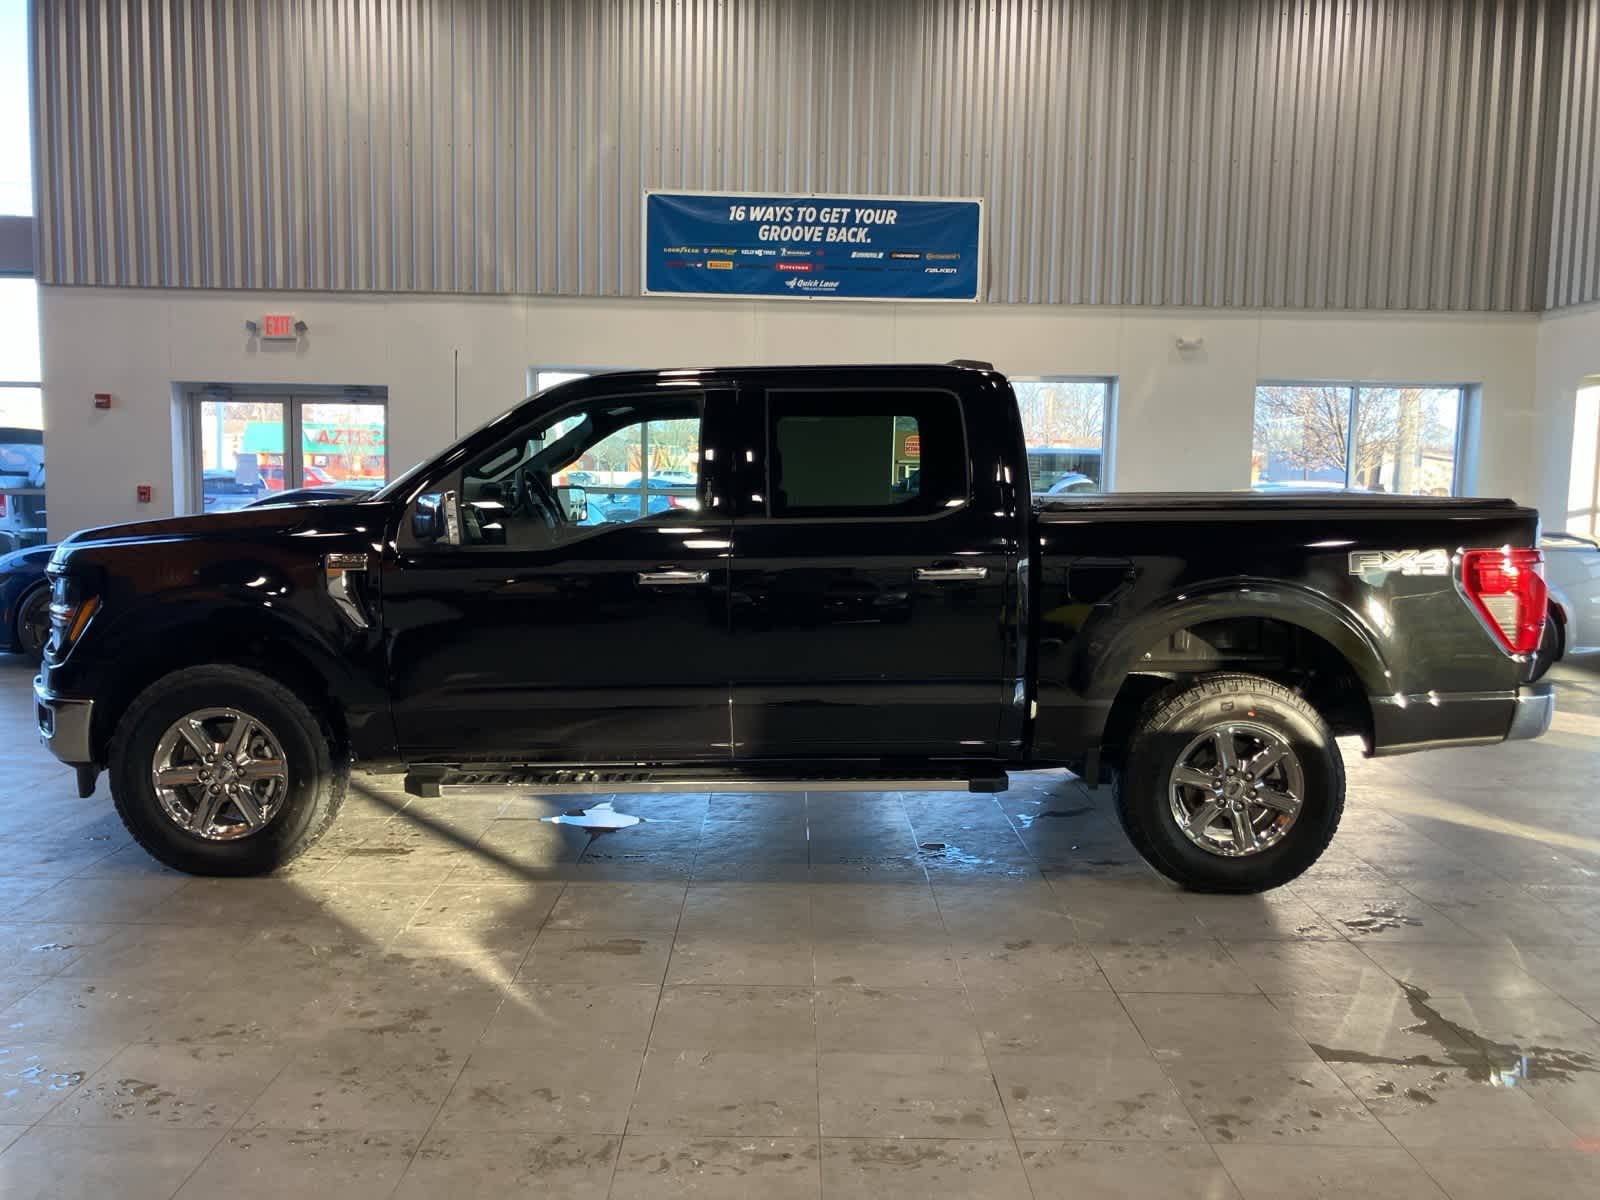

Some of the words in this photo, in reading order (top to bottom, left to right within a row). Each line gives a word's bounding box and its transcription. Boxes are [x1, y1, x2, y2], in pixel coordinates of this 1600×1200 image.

[729, 206, 746, 221] 16
[749, 206, 794, 222] WAYS
[797, 207, 817, 223] TO
[819, 208, 851, 224] GET
[854, 208, 898, 225] YOUR
[758, 225, 824, 242] GROOVE
[825, 227, 872, 243] BACK.
[265, 315, 289, 337] EXIT
[316, 428, 385, 447] AZTEC
[1348, 549, 1449, 576] FX4
